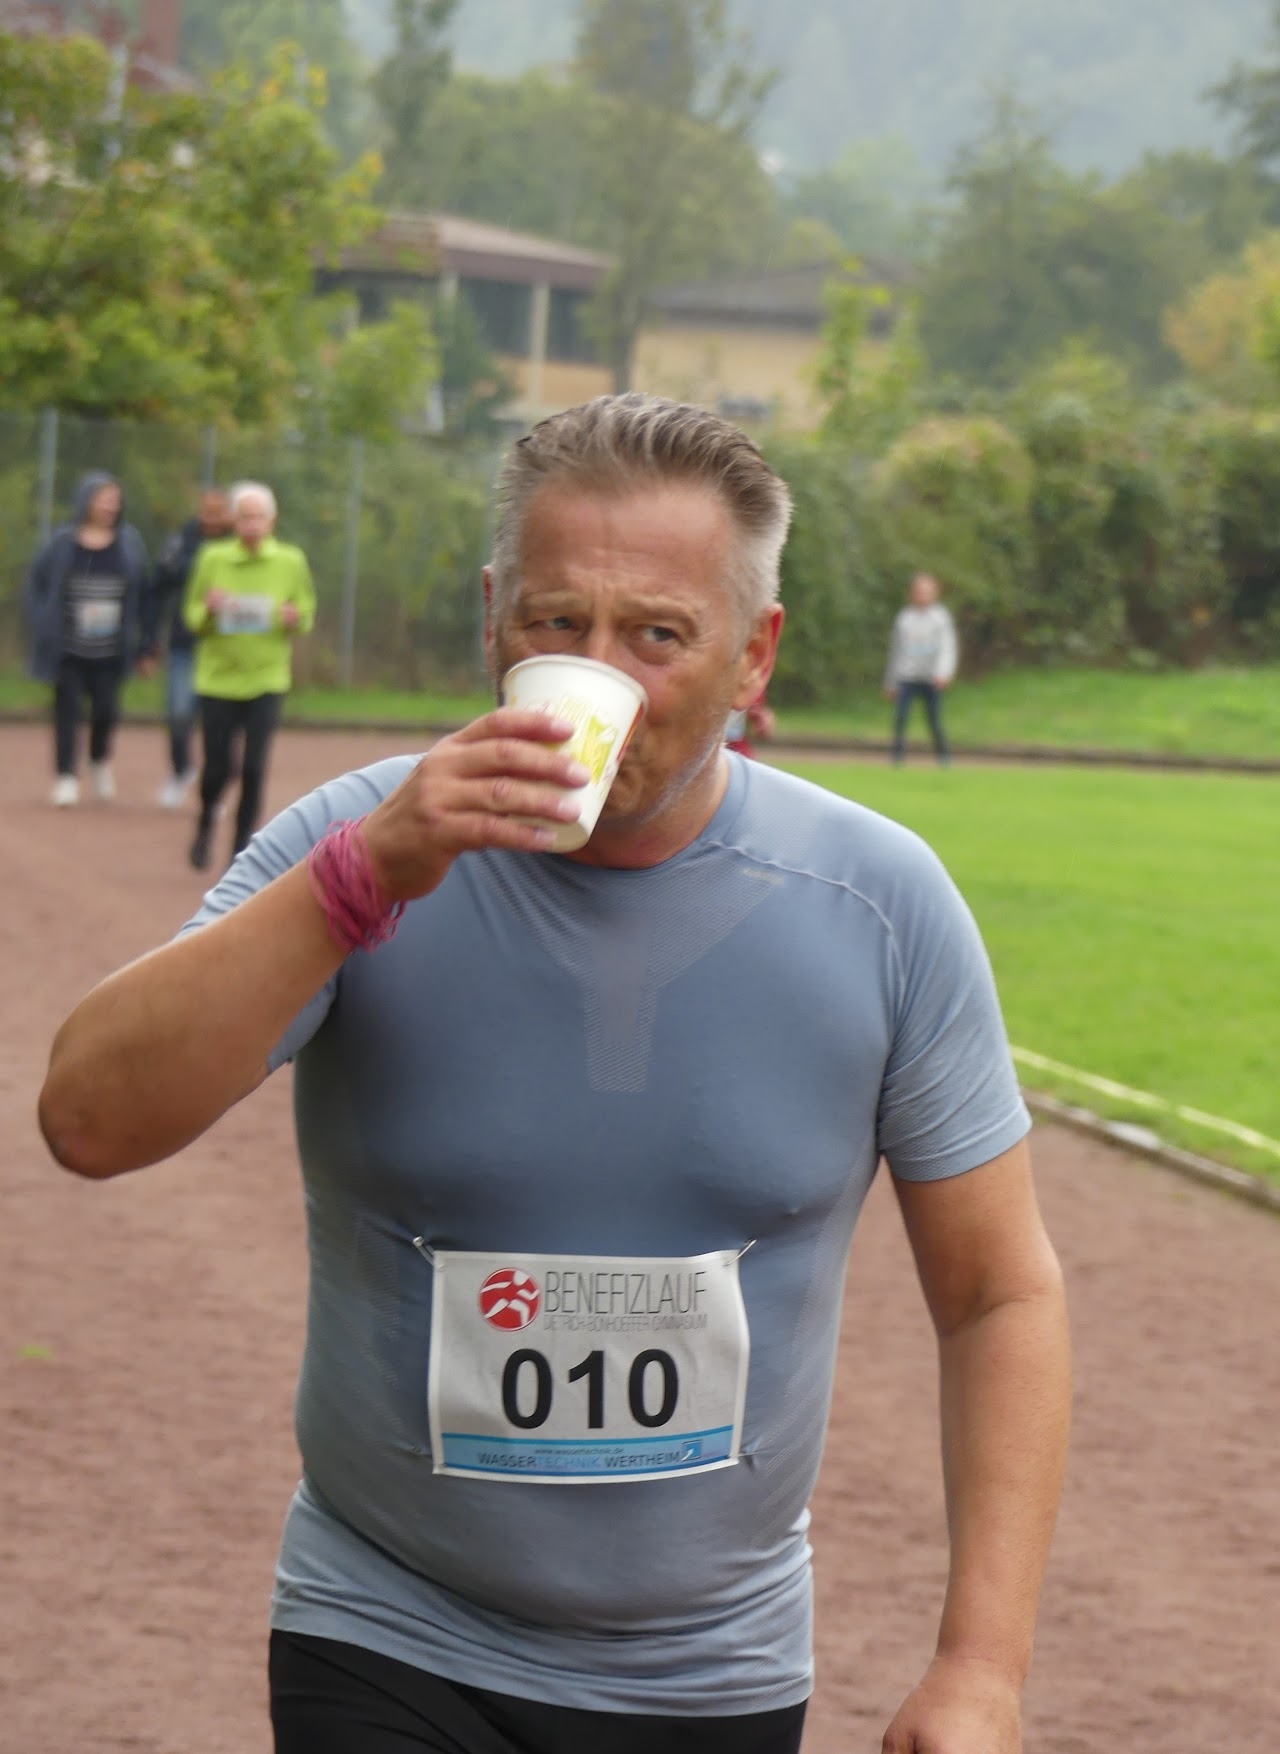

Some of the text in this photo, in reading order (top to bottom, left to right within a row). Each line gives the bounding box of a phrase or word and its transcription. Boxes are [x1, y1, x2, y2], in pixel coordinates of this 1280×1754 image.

[544, 1271, 707, 1315] BENEFIZLAUF
[502, 1348, 679, 1429] 010
[604, 1451, 680, 1468] WERTHEIM
